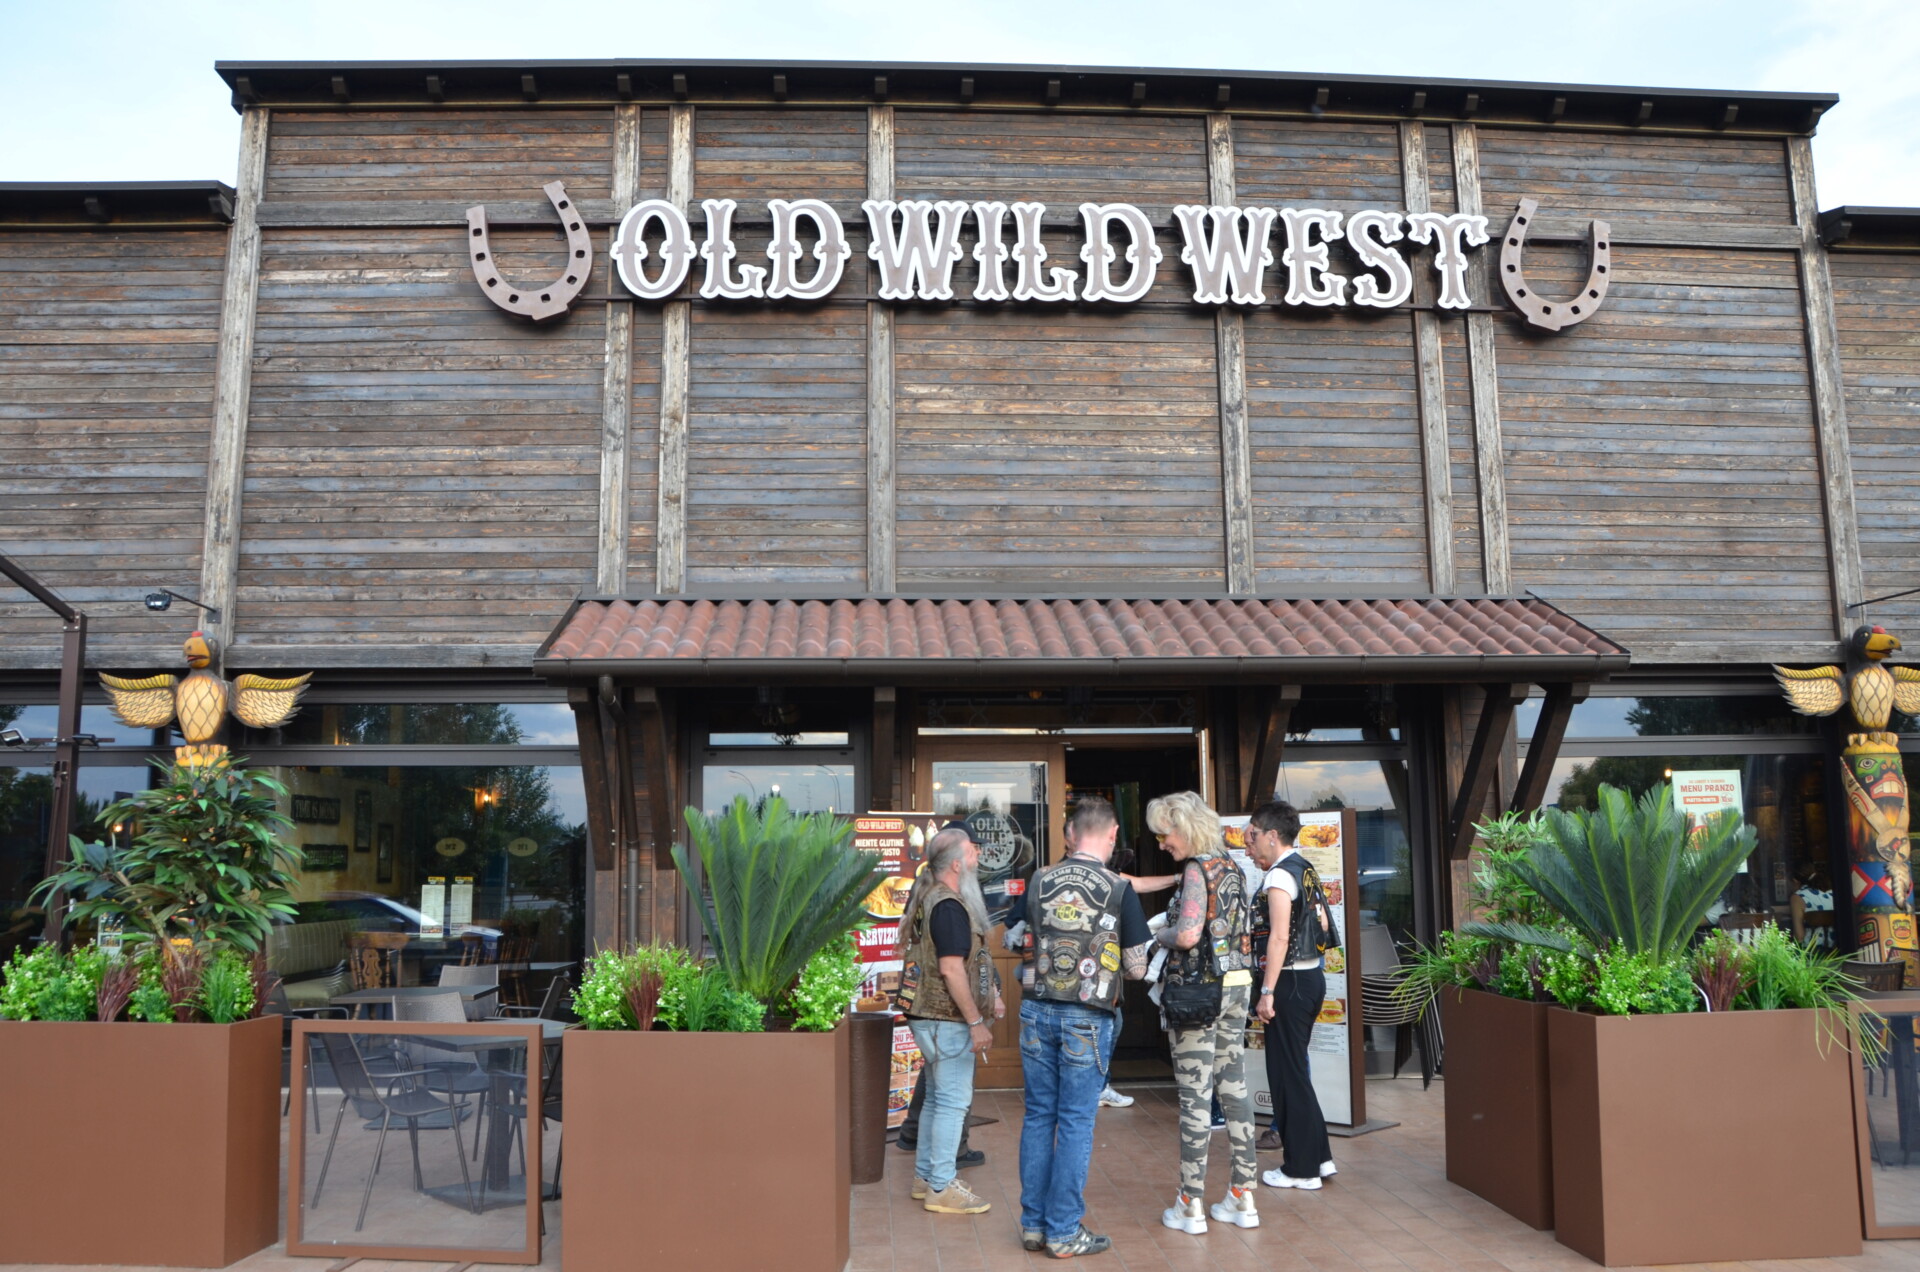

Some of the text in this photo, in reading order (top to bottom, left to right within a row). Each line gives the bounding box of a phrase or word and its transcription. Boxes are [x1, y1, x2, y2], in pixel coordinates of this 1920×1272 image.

[610, 199, 1491, 311] OLD WILD WEST
[976, 817, 1003, 831] OLD
[855, 839, 904, 847] NIENTE GLUTINE
[1043, 867, 1109, 892] WILLIAM TELL CHAPTER
[1054, 874, 1096, 890] SWITZERLAND
